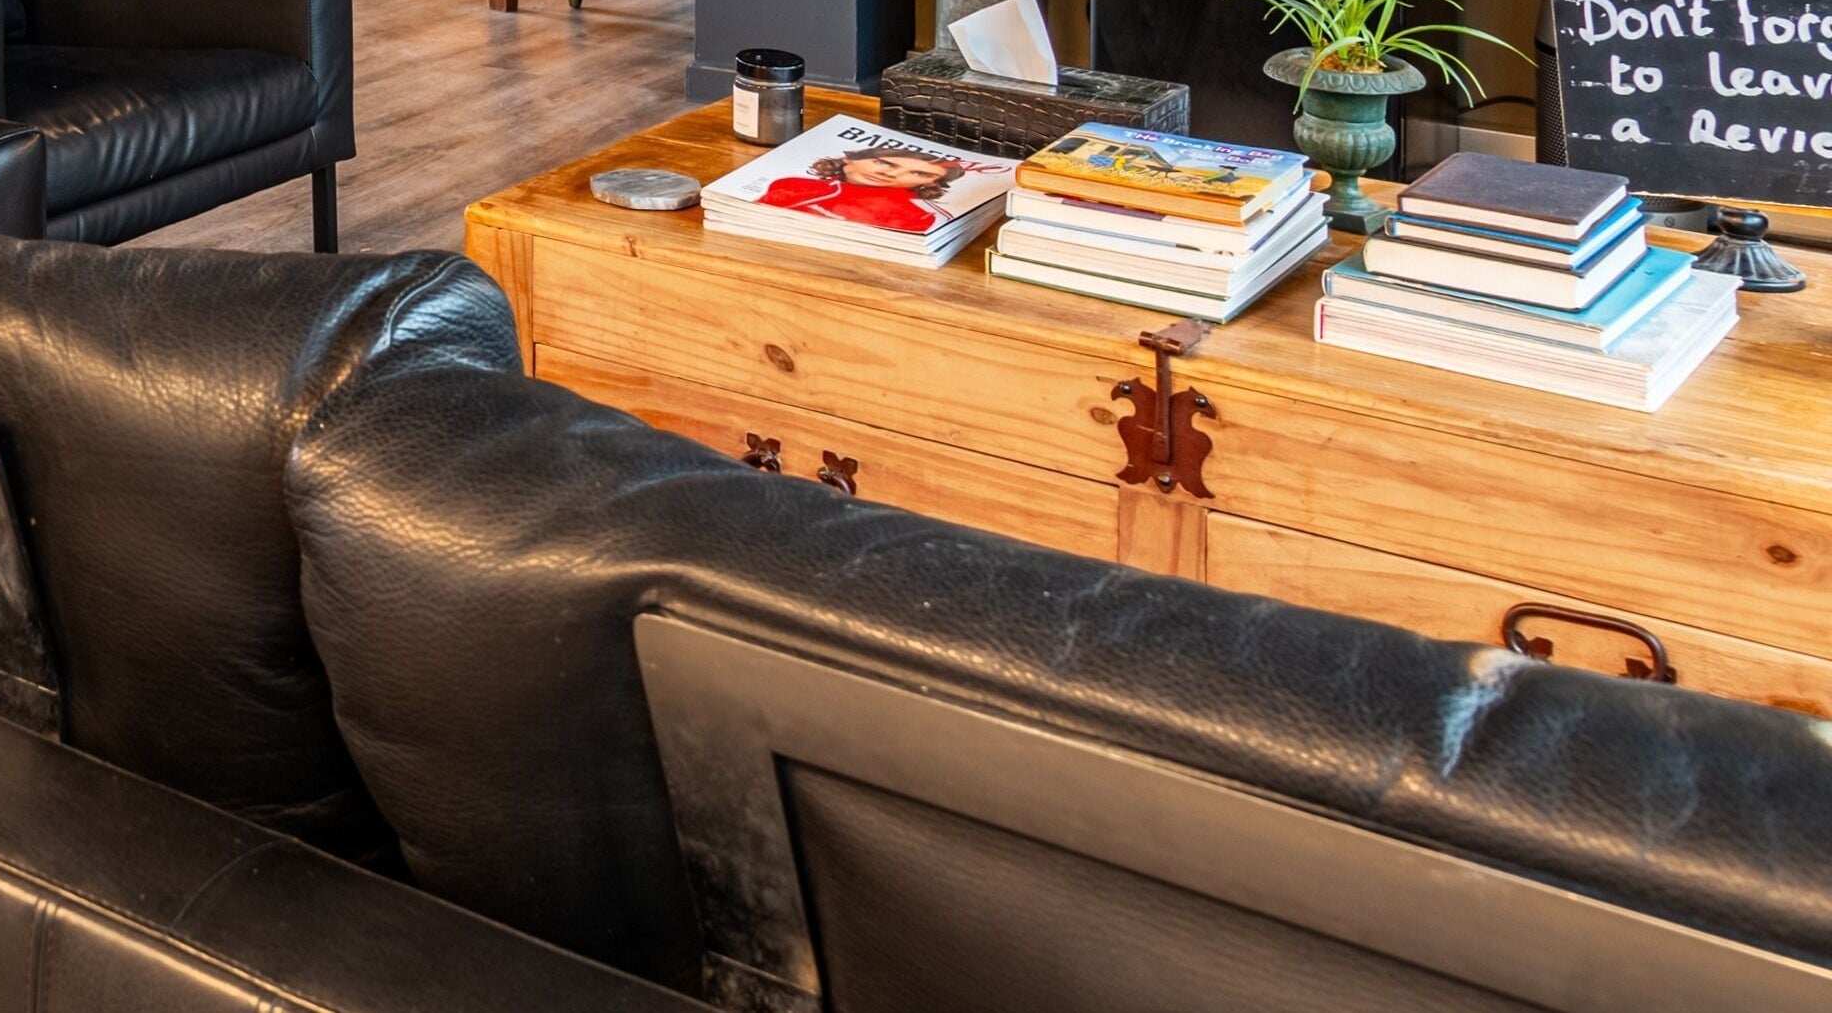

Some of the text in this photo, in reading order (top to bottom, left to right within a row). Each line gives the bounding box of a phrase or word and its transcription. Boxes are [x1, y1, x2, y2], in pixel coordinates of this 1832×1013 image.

[1610, 51, 1832, 100] to leav
[1611, 118, 1651, 144] a
